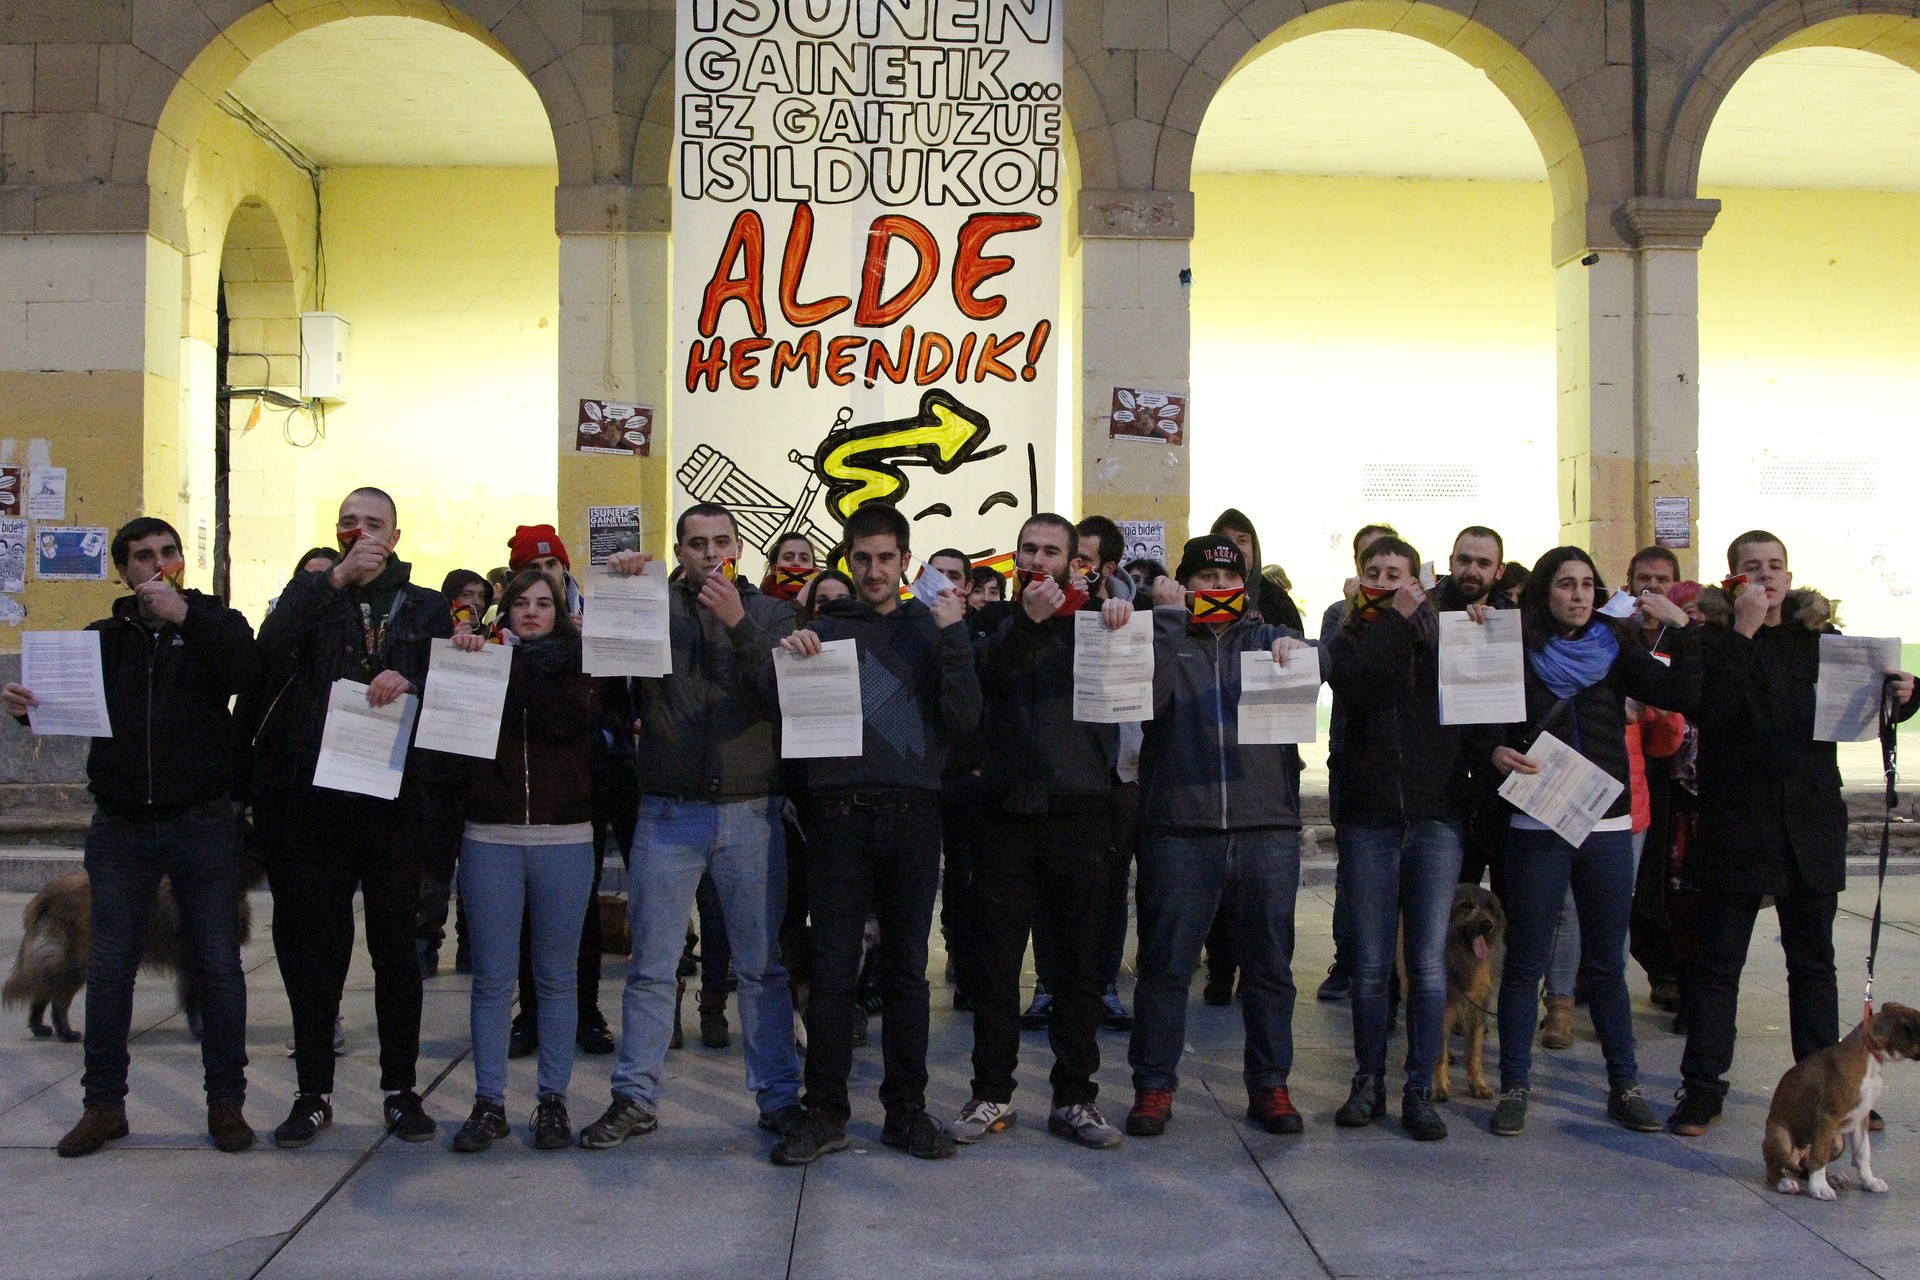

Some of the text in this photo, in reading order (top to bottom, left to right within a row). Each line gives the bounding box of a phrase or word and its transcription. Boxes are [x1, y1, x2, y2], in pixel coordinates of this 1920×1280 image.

[692, 0, 1053, 43] ISUNEN
[684, 37, 1062, 101] GAINETIK...
[681, 94, 1062, 146] EZ GAITUZUE
[680, 141, 1059, 206] ISILDUKO!
[698, 201, 1043, 338] ALDE
[685, 319, 1052, 393] HEMENDIK!
[1, 521, 19, 533] bide
[590, 508, 628, 517] ISUNEN
[1138, 523, 1155, 536] bide
